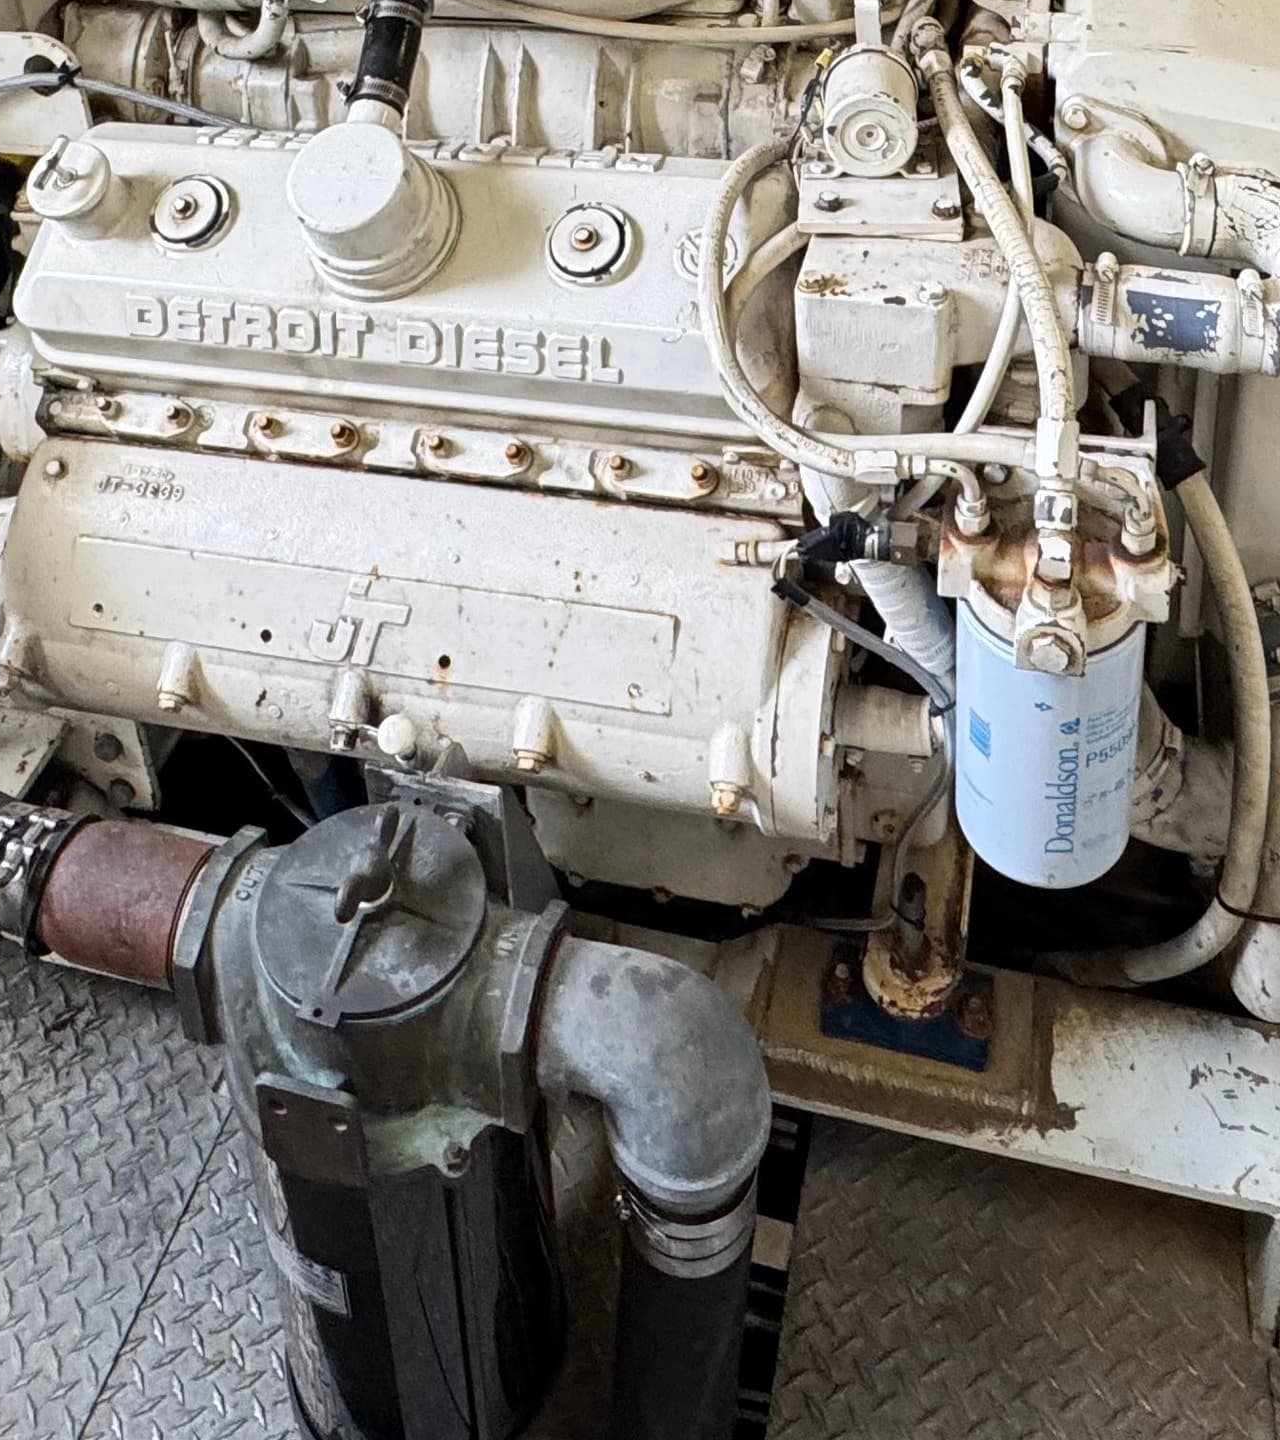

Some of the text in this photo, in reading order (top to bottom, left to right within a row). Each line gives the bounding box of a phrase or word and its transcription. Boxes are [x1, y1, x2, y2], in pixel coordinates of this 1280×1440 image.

[126, 292, 624, 385] DETROIT DIESEL
[234, 863, 266, 903] OUT
